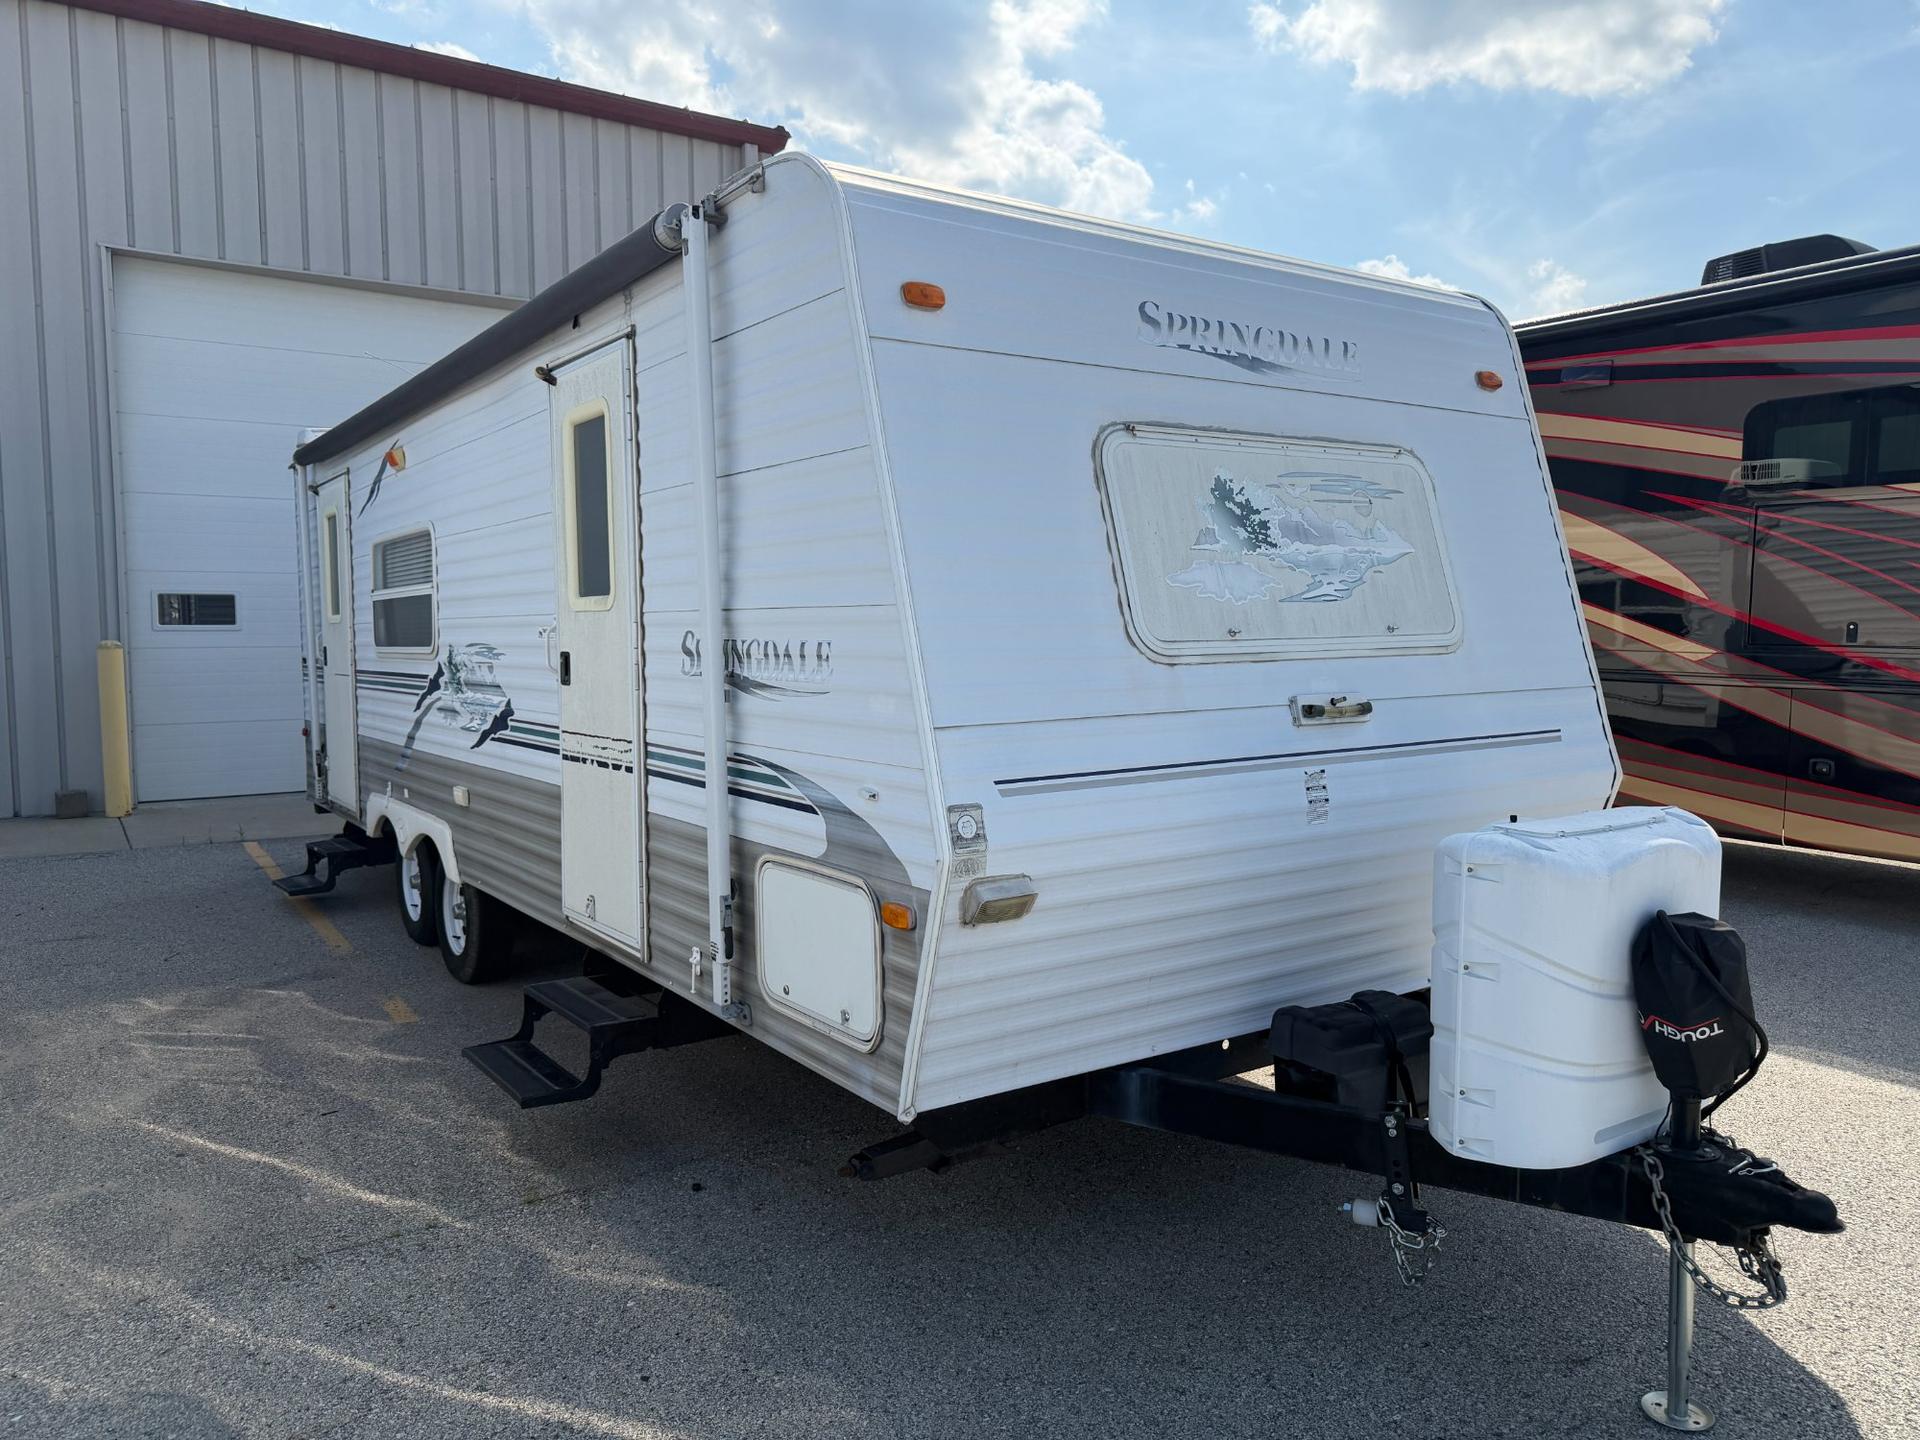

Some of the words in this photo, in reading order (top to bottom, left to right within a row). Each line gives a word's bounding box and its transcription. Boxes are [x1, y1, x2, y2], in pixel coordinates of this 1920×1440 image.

[1138, 300, 1360, 373] SPRINGDALE
[681, 630, 833, 680] SINGDALE
[1655, 1020, 1723, 1042] TOUGH
